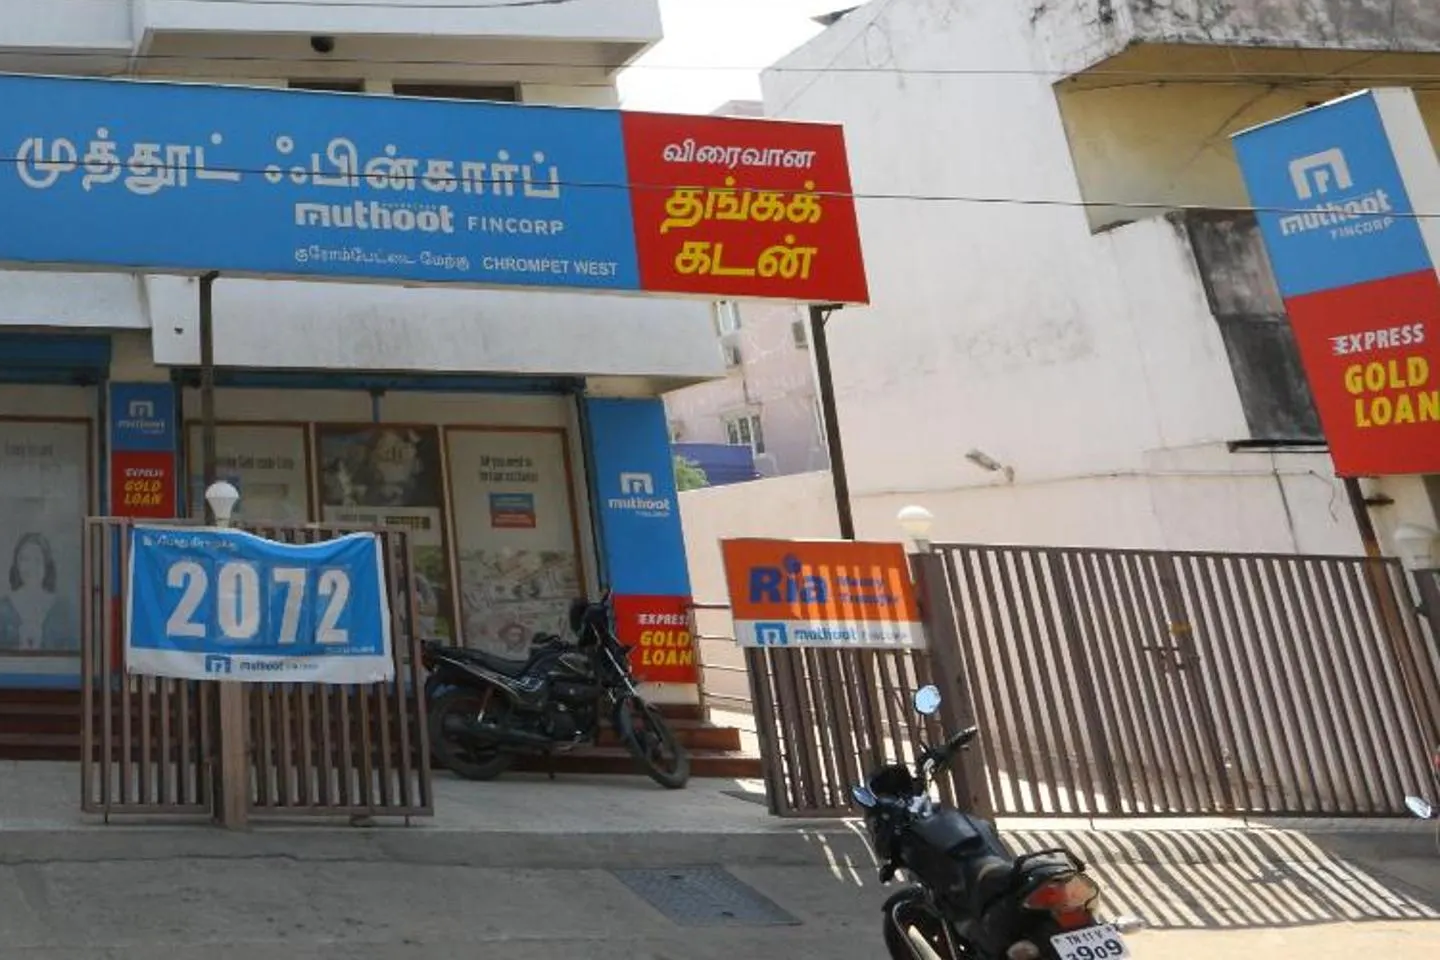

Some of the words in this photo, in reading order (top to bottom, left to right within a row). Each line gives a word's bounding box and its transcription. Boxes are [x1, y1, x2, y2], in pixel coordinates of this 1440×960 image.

[16, 127, 241, 195] முத்தூட்
[264, 136, 560, 199] ஃபின்கார்ப்
[663, 138, 816, 169] விரைவான
[294, 200, 455, 233] muthoot
[467, 215, 564, 235] FINCORP
[660, 175, 822, 234] தங்கக்
[1279, 188, 1393, 236] muthoot
[1329, 216, 1394, 240] FINCORP
[482, 256, 569, 274] CHROMPET
[573, 260, 618, 277] WEST
[675, 234, 818, 280] கடன்
[1332, 323, 1425, 355] EXPRESS
[1344, 356, 1429, 395] GOLD
[1355, 391, 1440, 428] LOAN
[124, 479, 162, 492] GOLD
[124, 492, 163, 506] LOAN
[749, 552, 828, 605] Ria
[166, 558, 351, 644] 2072
[641, 630, 690, 647] GOLD
[642, 649, 693, 666] LOAN
